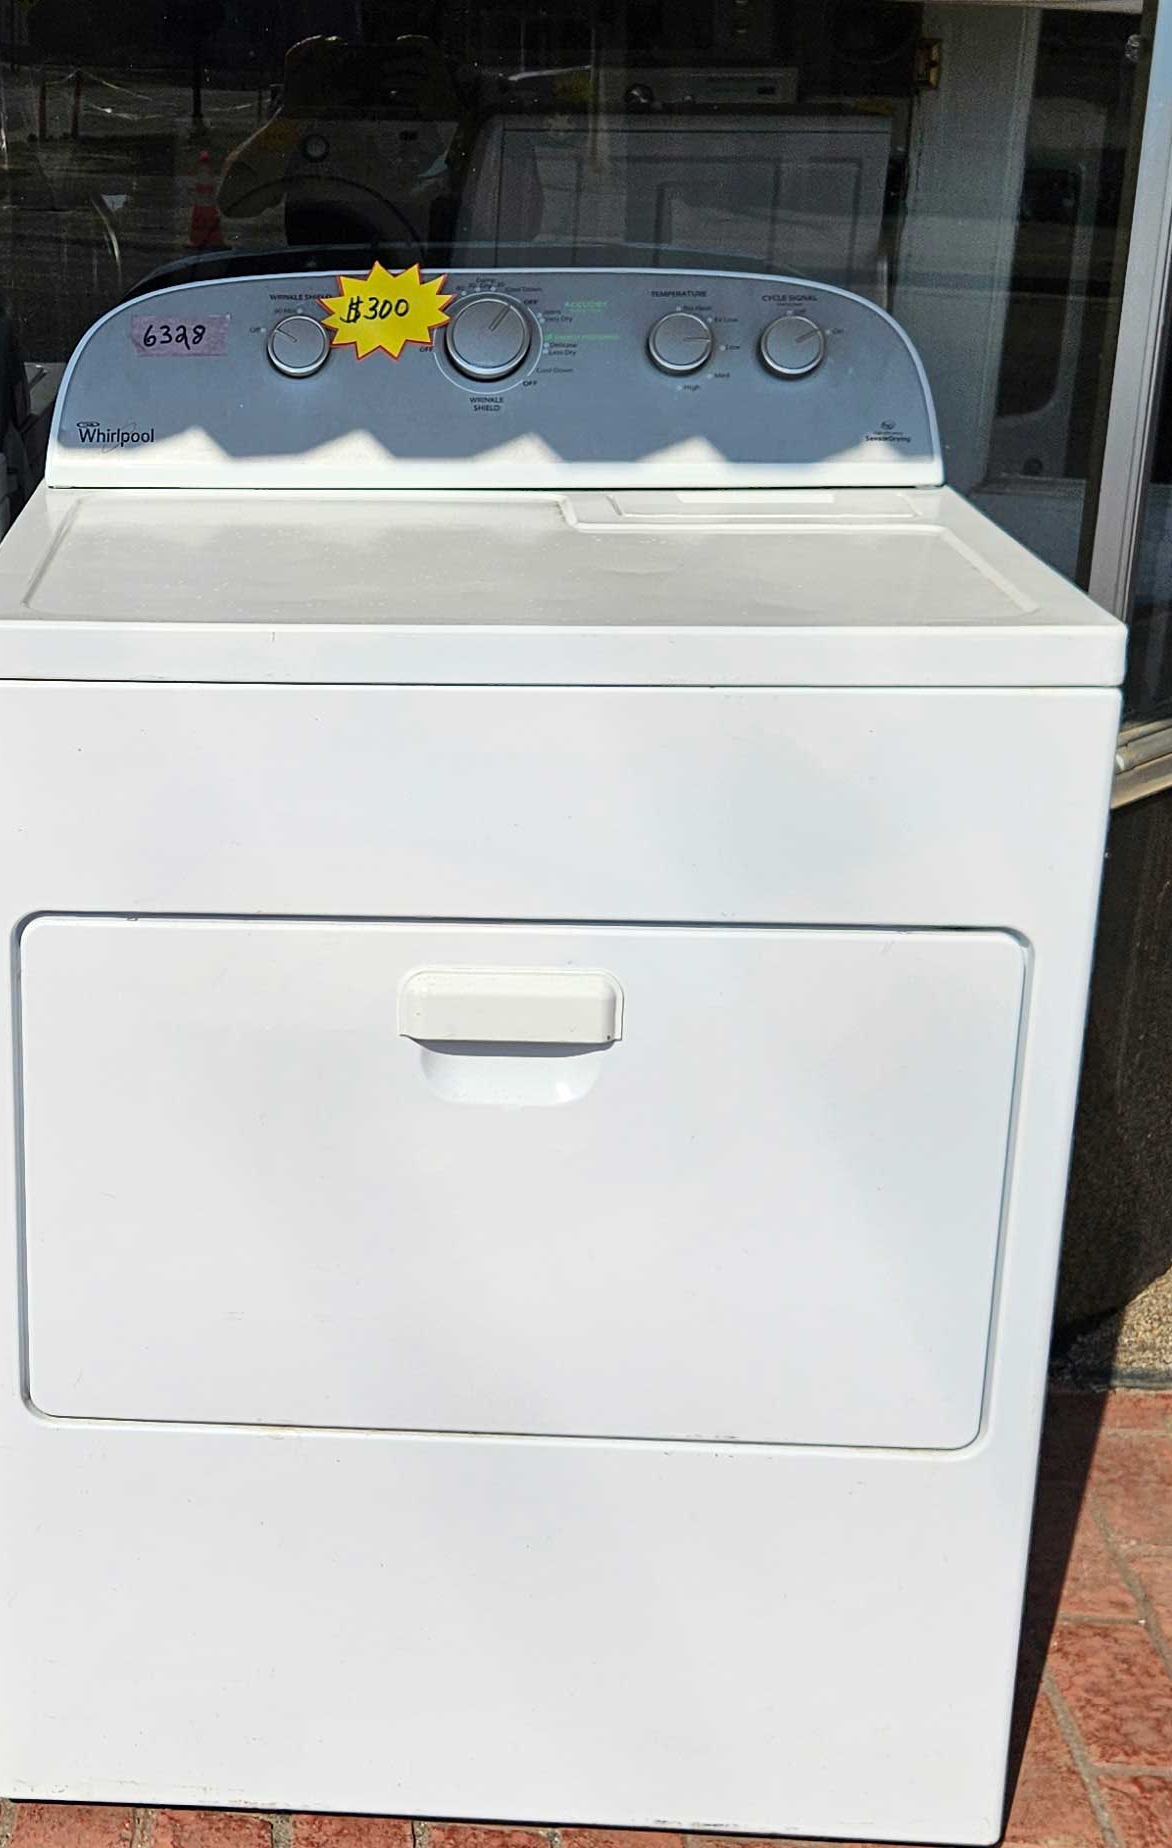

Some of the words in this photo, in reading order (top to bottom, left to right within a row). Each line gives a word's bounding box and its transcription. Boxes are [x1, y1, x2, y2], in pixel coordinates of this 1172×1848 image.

[340, 296, 410, 323] $300
[143, 324, 206, 350] 6328
[78, 428, 154, 447] Whirlpool
